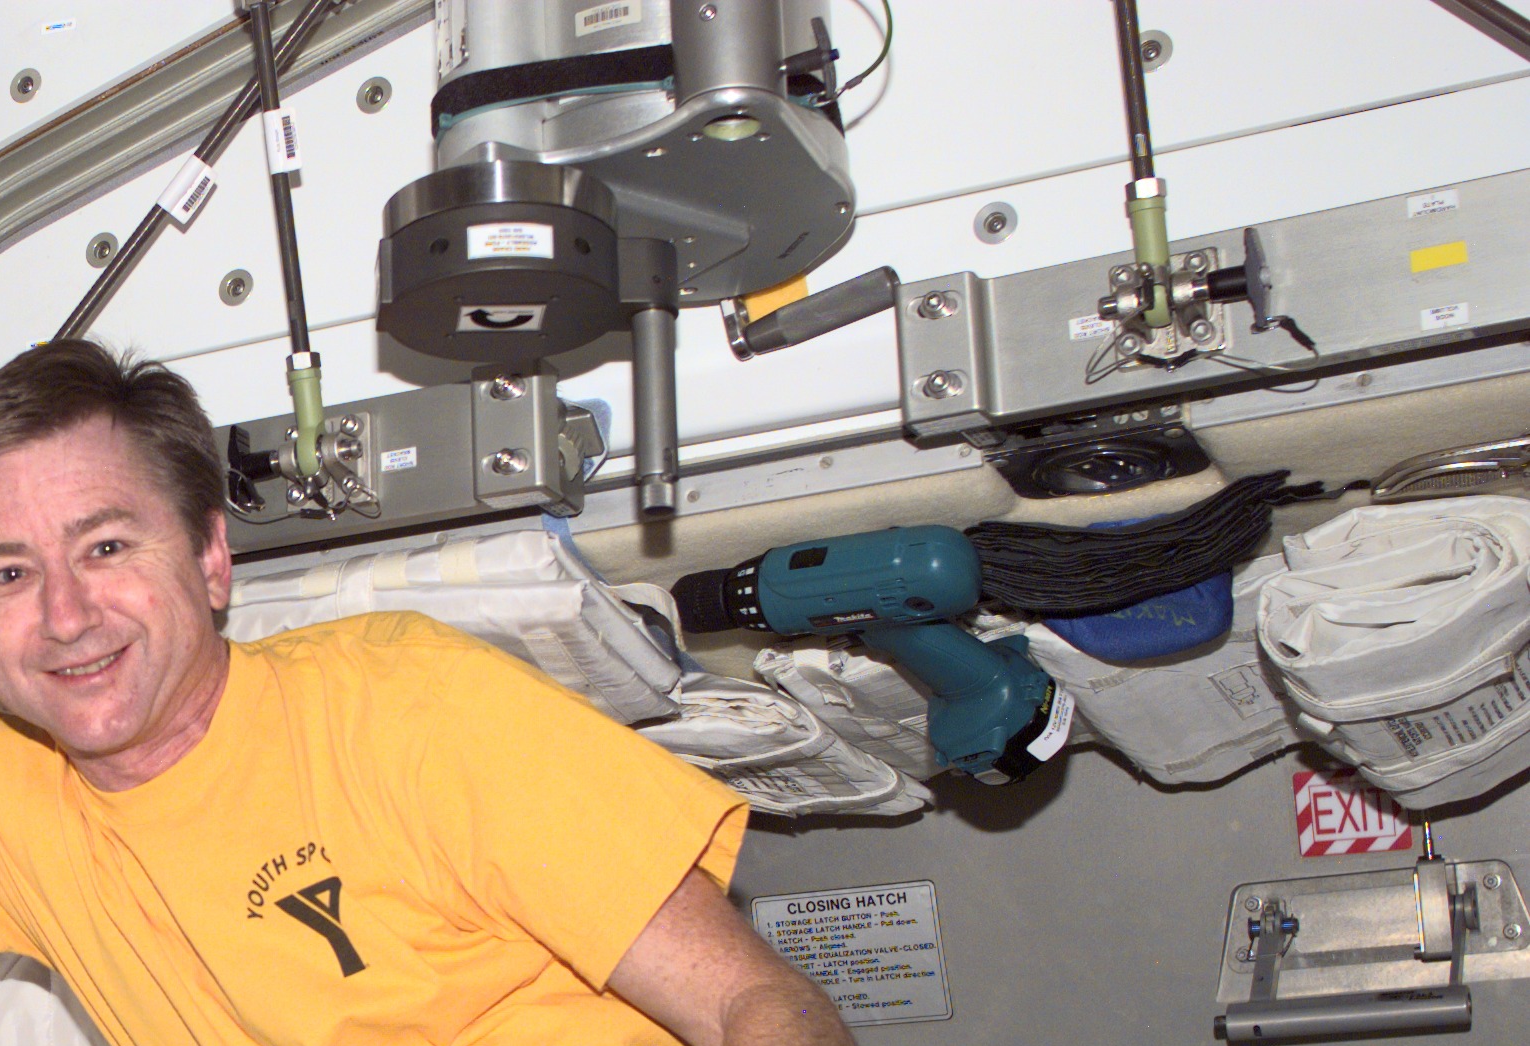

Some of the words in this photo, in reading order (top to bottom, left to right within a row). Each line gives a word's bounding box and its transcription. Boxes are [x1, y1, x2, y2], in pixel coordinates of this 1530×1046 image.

[1312, 788, 1384, 836] EXIT
[246, 854, 288, 920] YOUTH
[787, 897, 851, 915] CLOSING
[856, 891, 908, 908] HATCH
[814, 916, 839, 925] LATCH
[841, 913, 872, 922] BUTTON
[815, 925, 840, 934] LATCH
[842, 922, 872, 931] HANDLE
[777, 937, 803, 945] HATCH
[818, 948, 873, 960] EQUALIZATION
[823, 960, 848, 968] LATCH
[809, 969, 839, 978] HANDLE
[875, 973, 901, 981] LATCH
